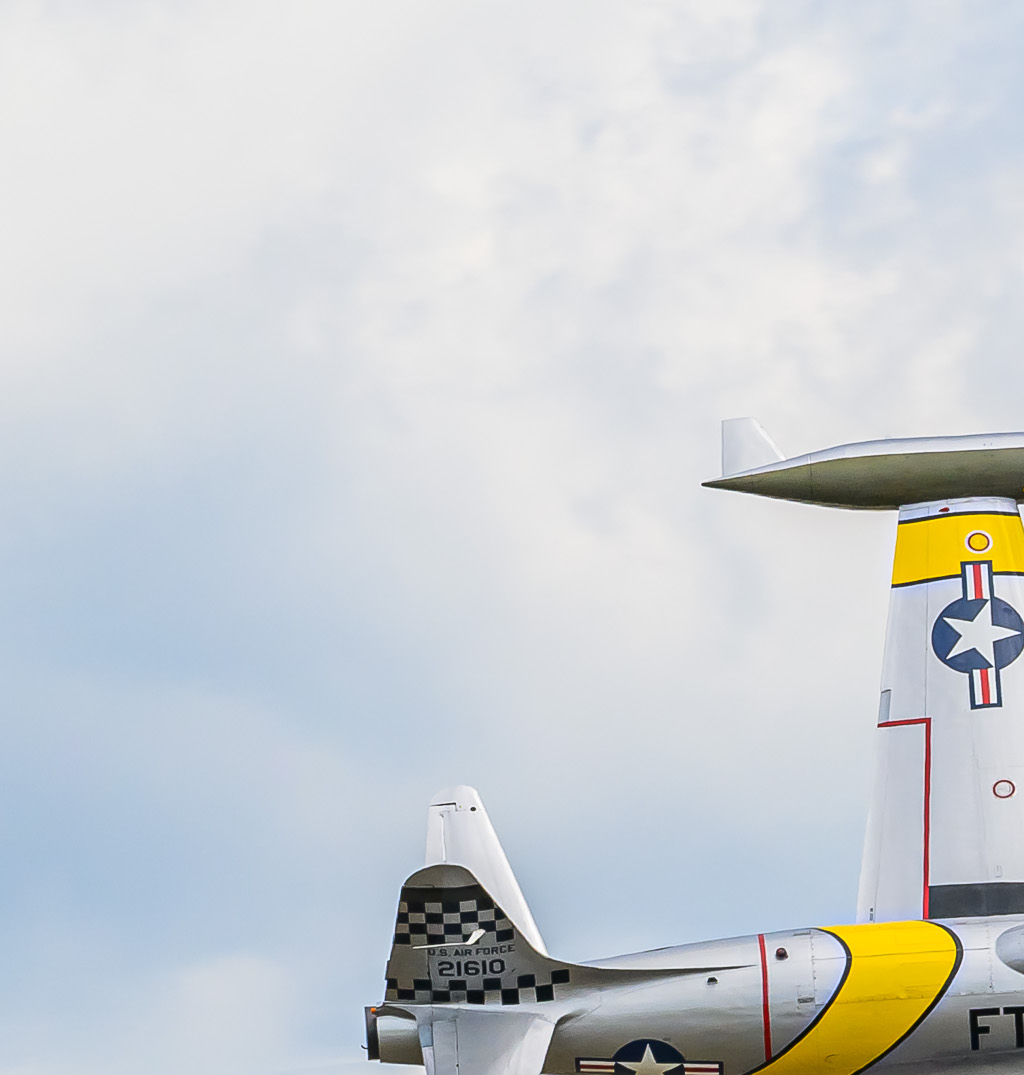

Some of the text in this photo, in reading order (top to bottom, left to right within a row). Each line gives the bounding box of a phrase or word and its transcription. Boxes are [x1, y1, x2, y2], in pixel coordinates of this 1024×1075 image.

[454, 948, 472, 956] AIR
[476, 944, 516, 955] FORCE
[437, 959, 506, 977] 21610
